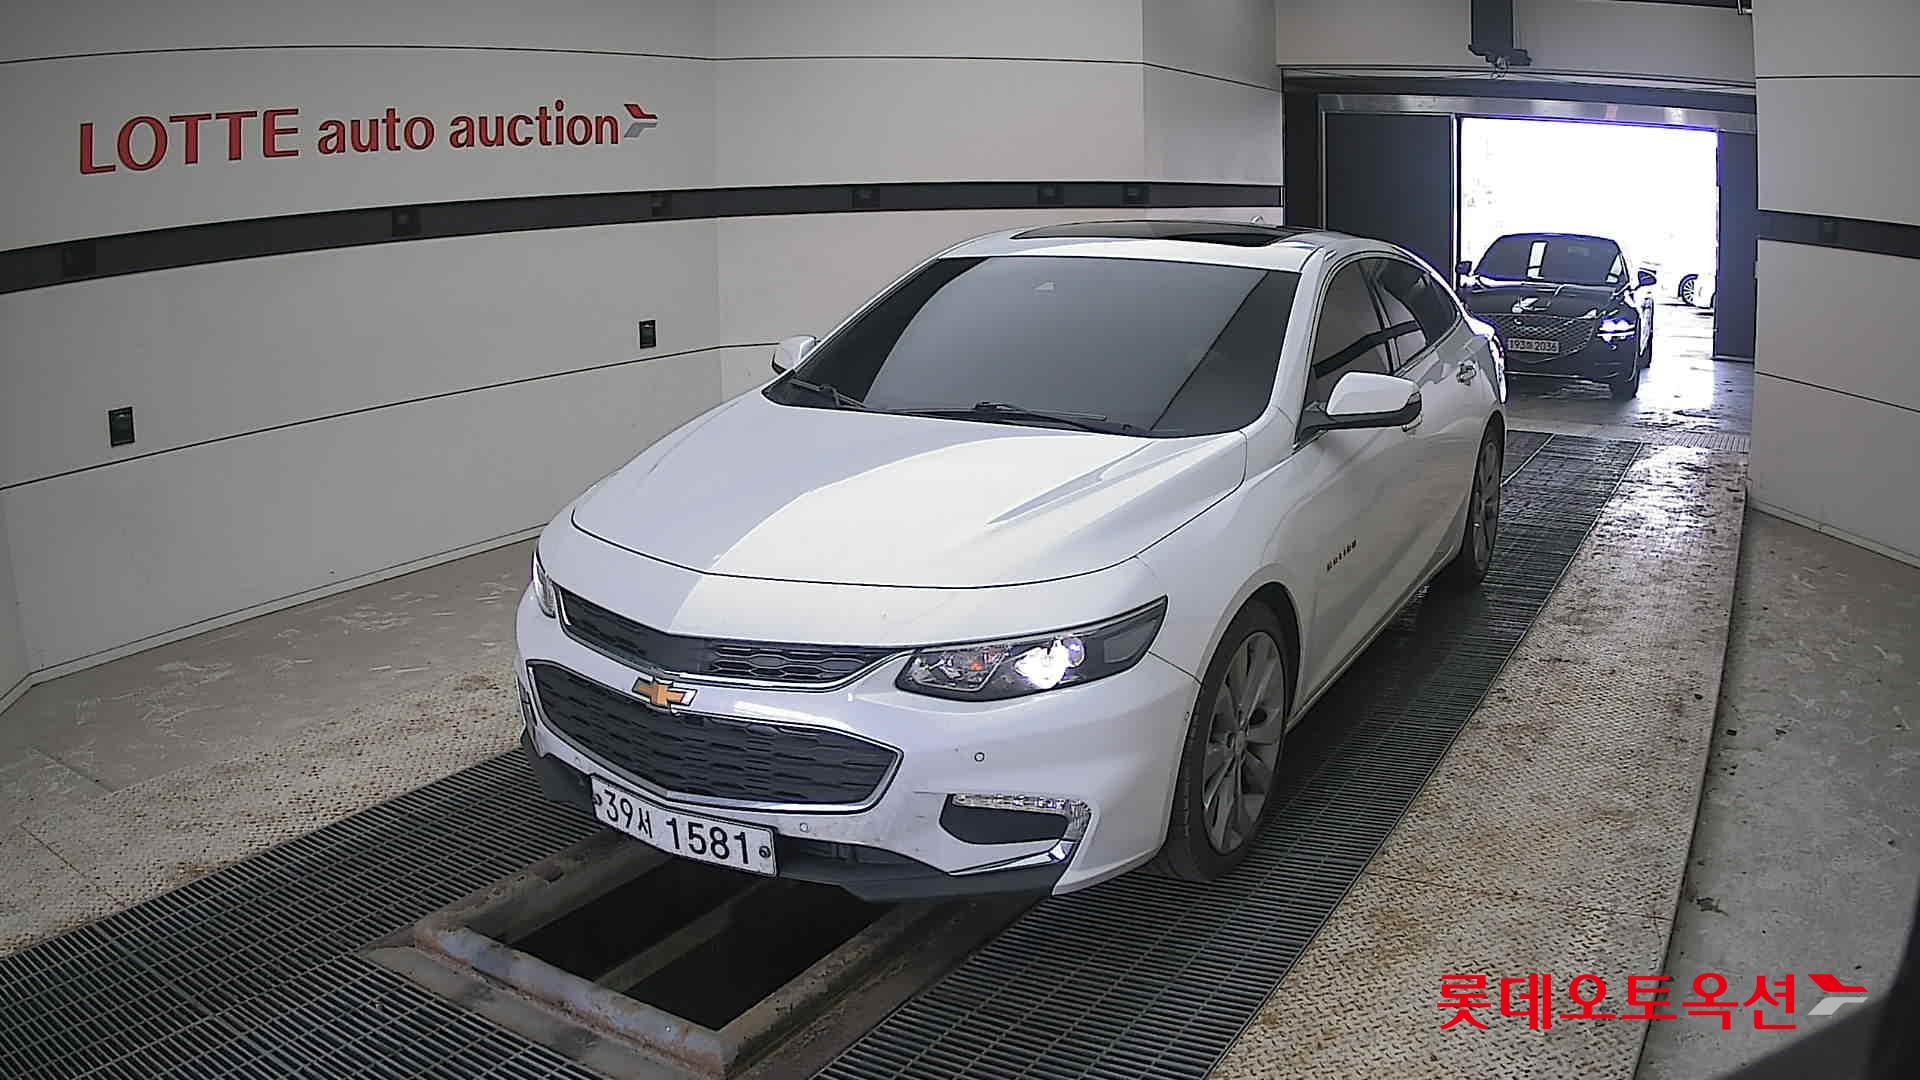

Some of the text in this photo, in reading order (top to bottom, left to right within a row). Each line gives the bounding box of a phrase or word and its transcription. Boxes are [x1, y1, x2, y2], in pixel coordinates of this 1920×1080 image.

[80, 100, 619, 175] LOTTE auto auction
[603, 789, 749, 865] 39서 1581
